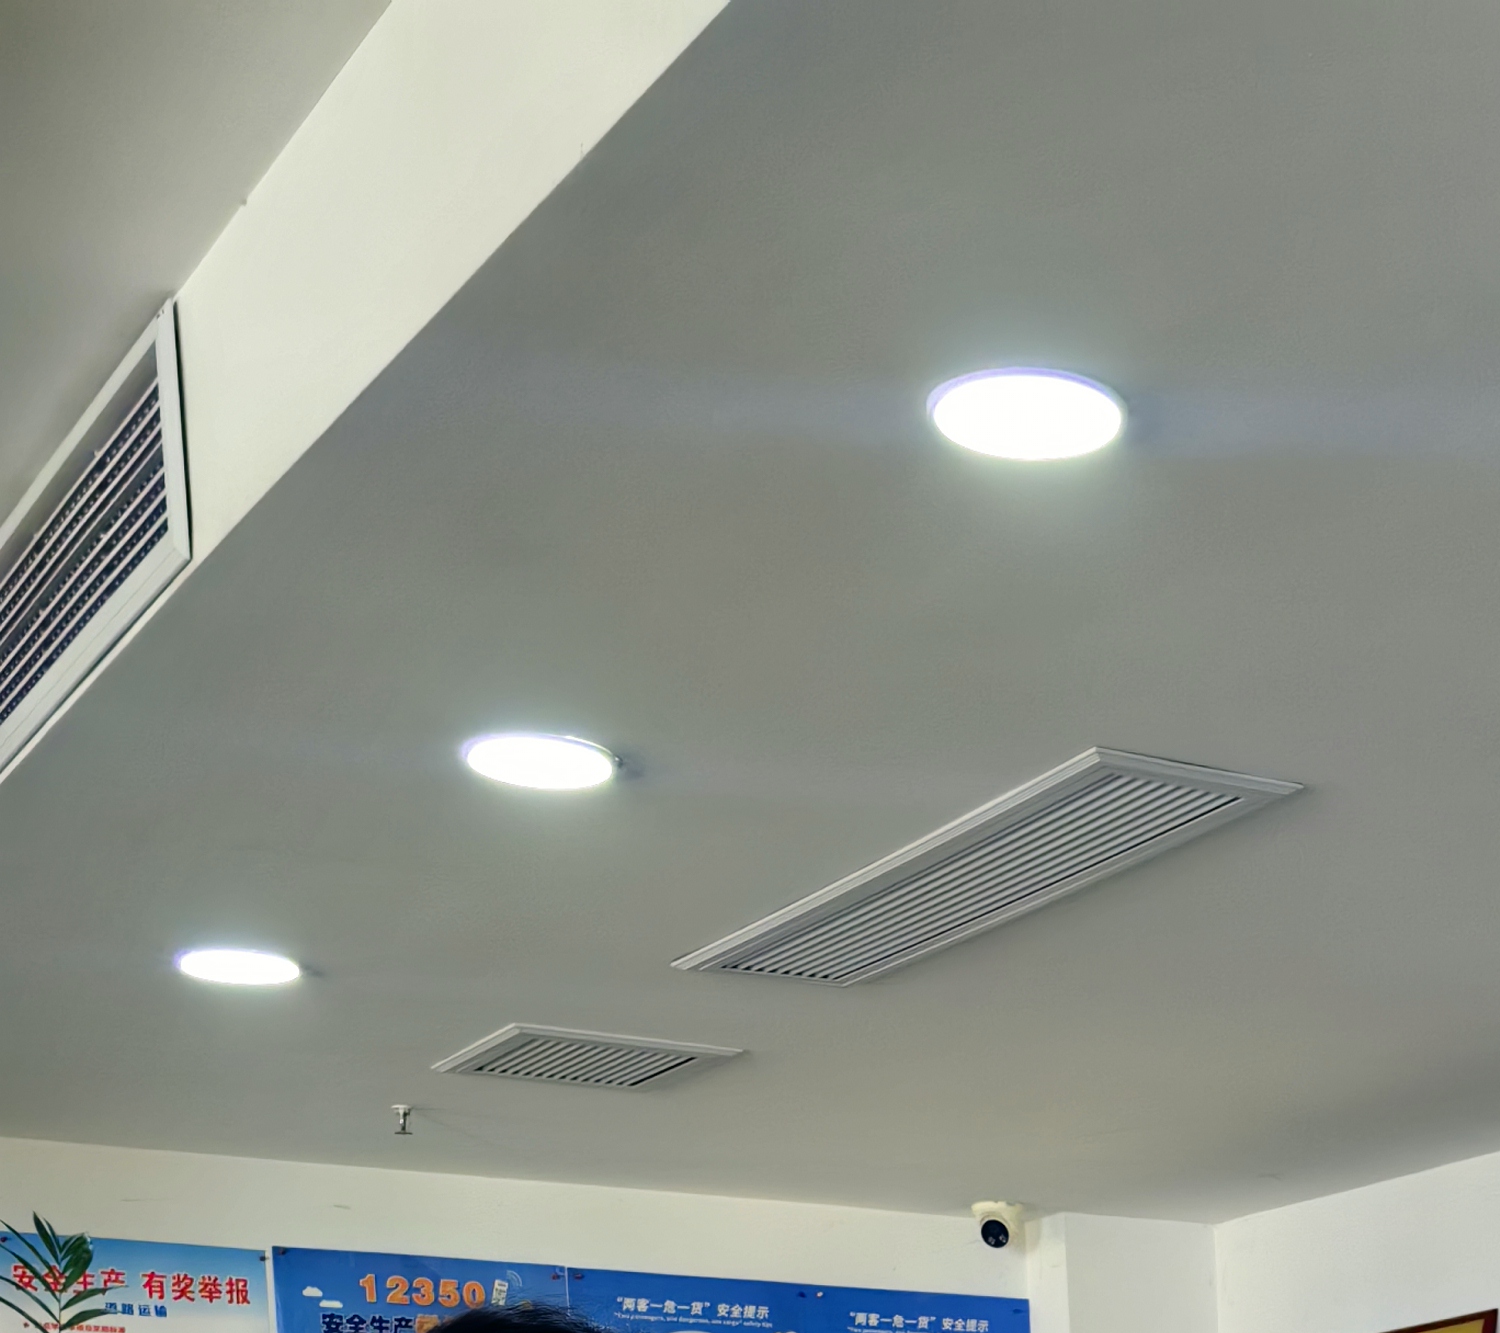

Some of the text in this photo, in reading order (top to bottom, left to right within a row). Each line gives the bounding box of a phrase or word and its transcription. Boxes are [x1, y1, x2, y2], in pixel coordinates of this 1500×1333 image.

[142, 1271, 251, 1305] 有奖举报
[359, 1273, 486, 1309] 12350
[105, 1302, 168, 1318] 道路运输
[717, 1303, 770, 1319] 安全提示
[942, 1318, 989, 1333] 安全提示
